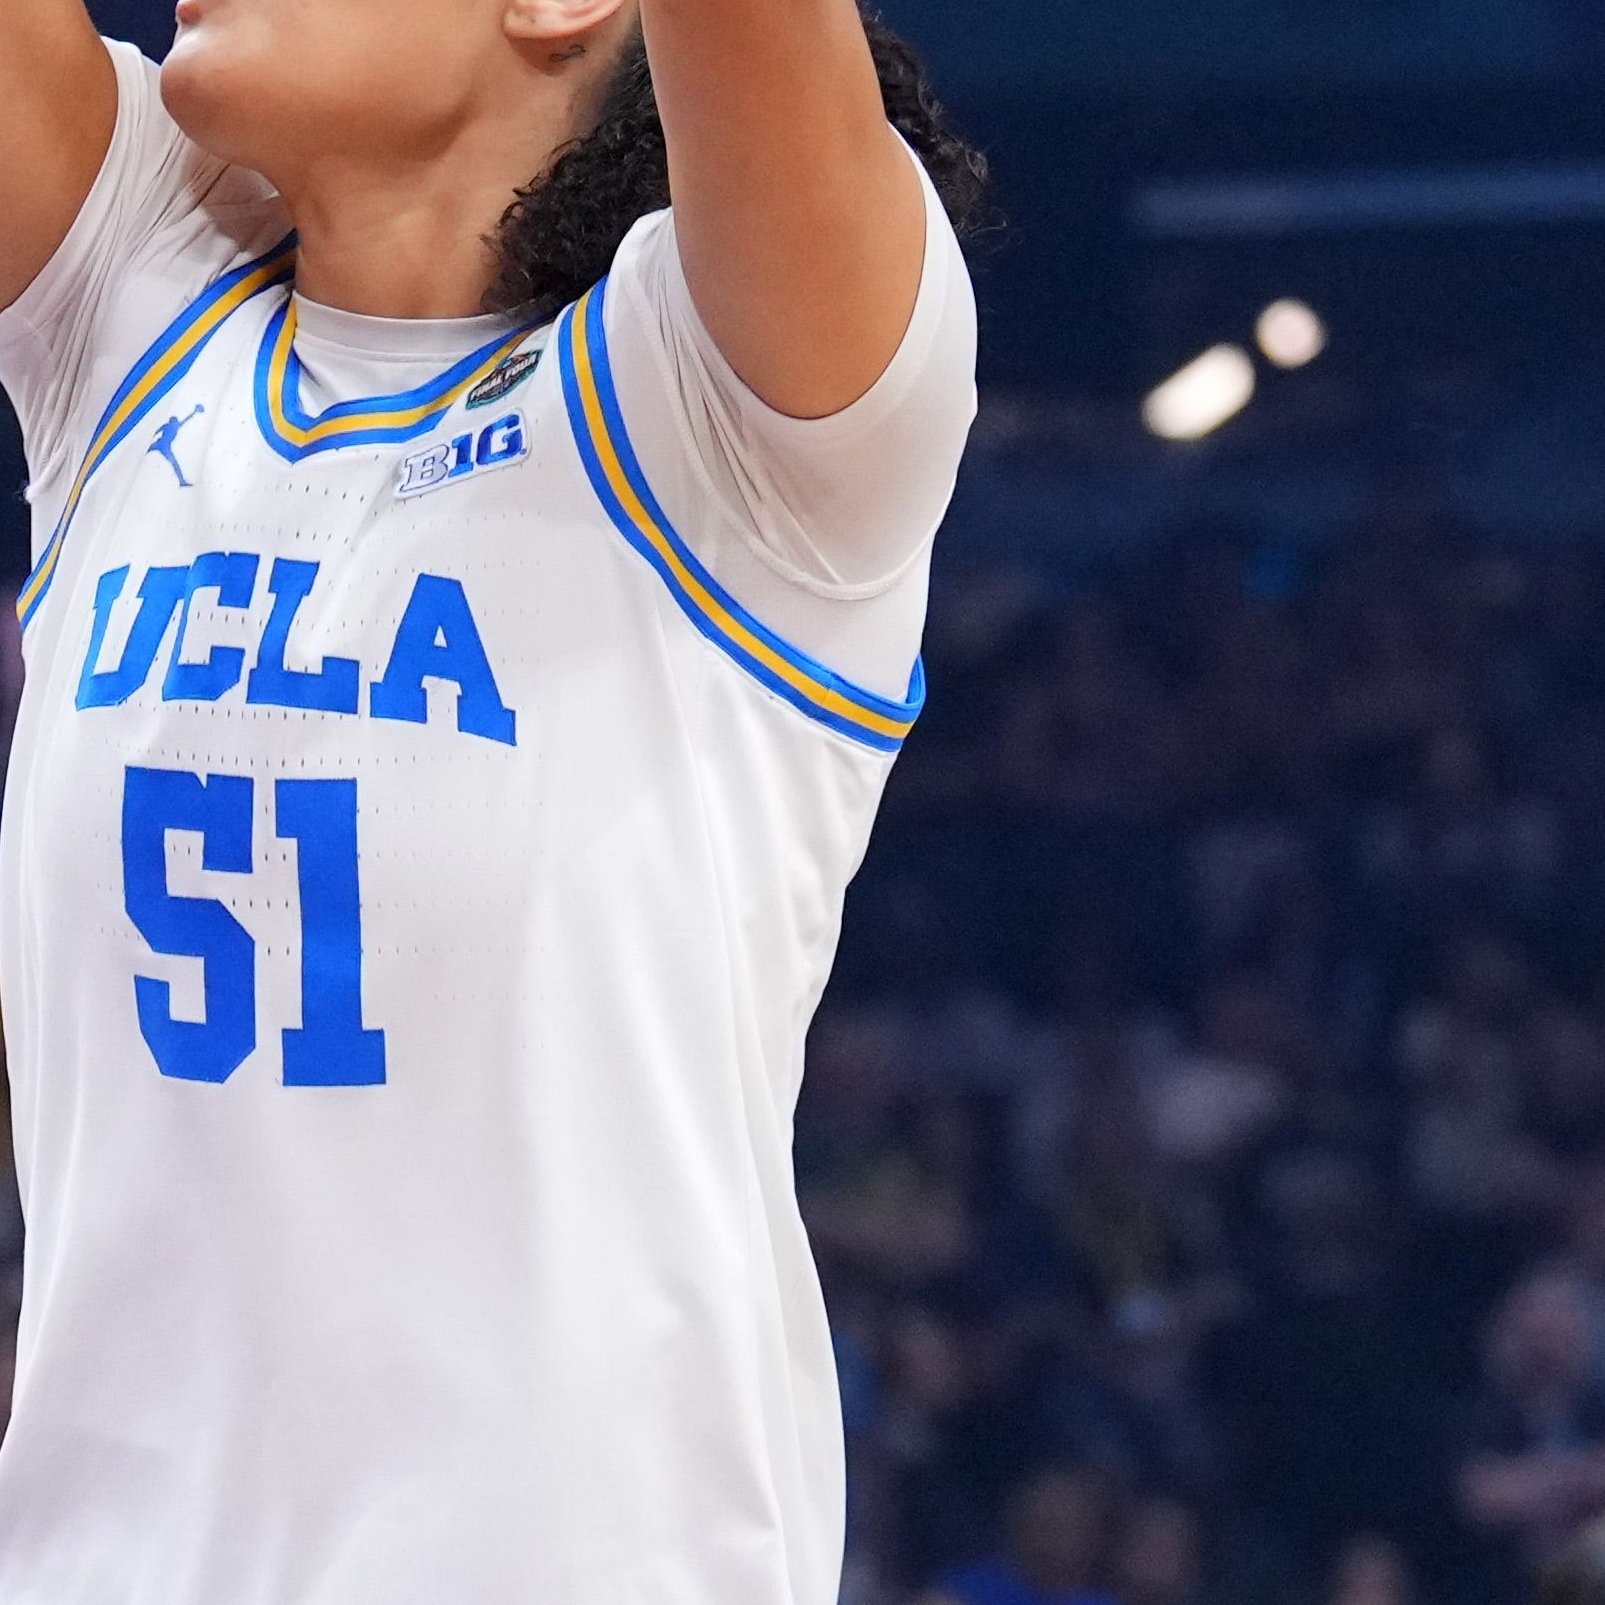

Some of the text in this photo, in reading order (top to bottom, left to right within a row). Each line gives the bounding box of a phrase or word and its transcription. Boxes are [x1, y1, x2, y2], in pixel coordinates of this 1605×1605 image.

[504, 355, 538, 380] FOUR
[75, 552, 517, 745] UCLA
[122, 766, 386, 1085] 51
